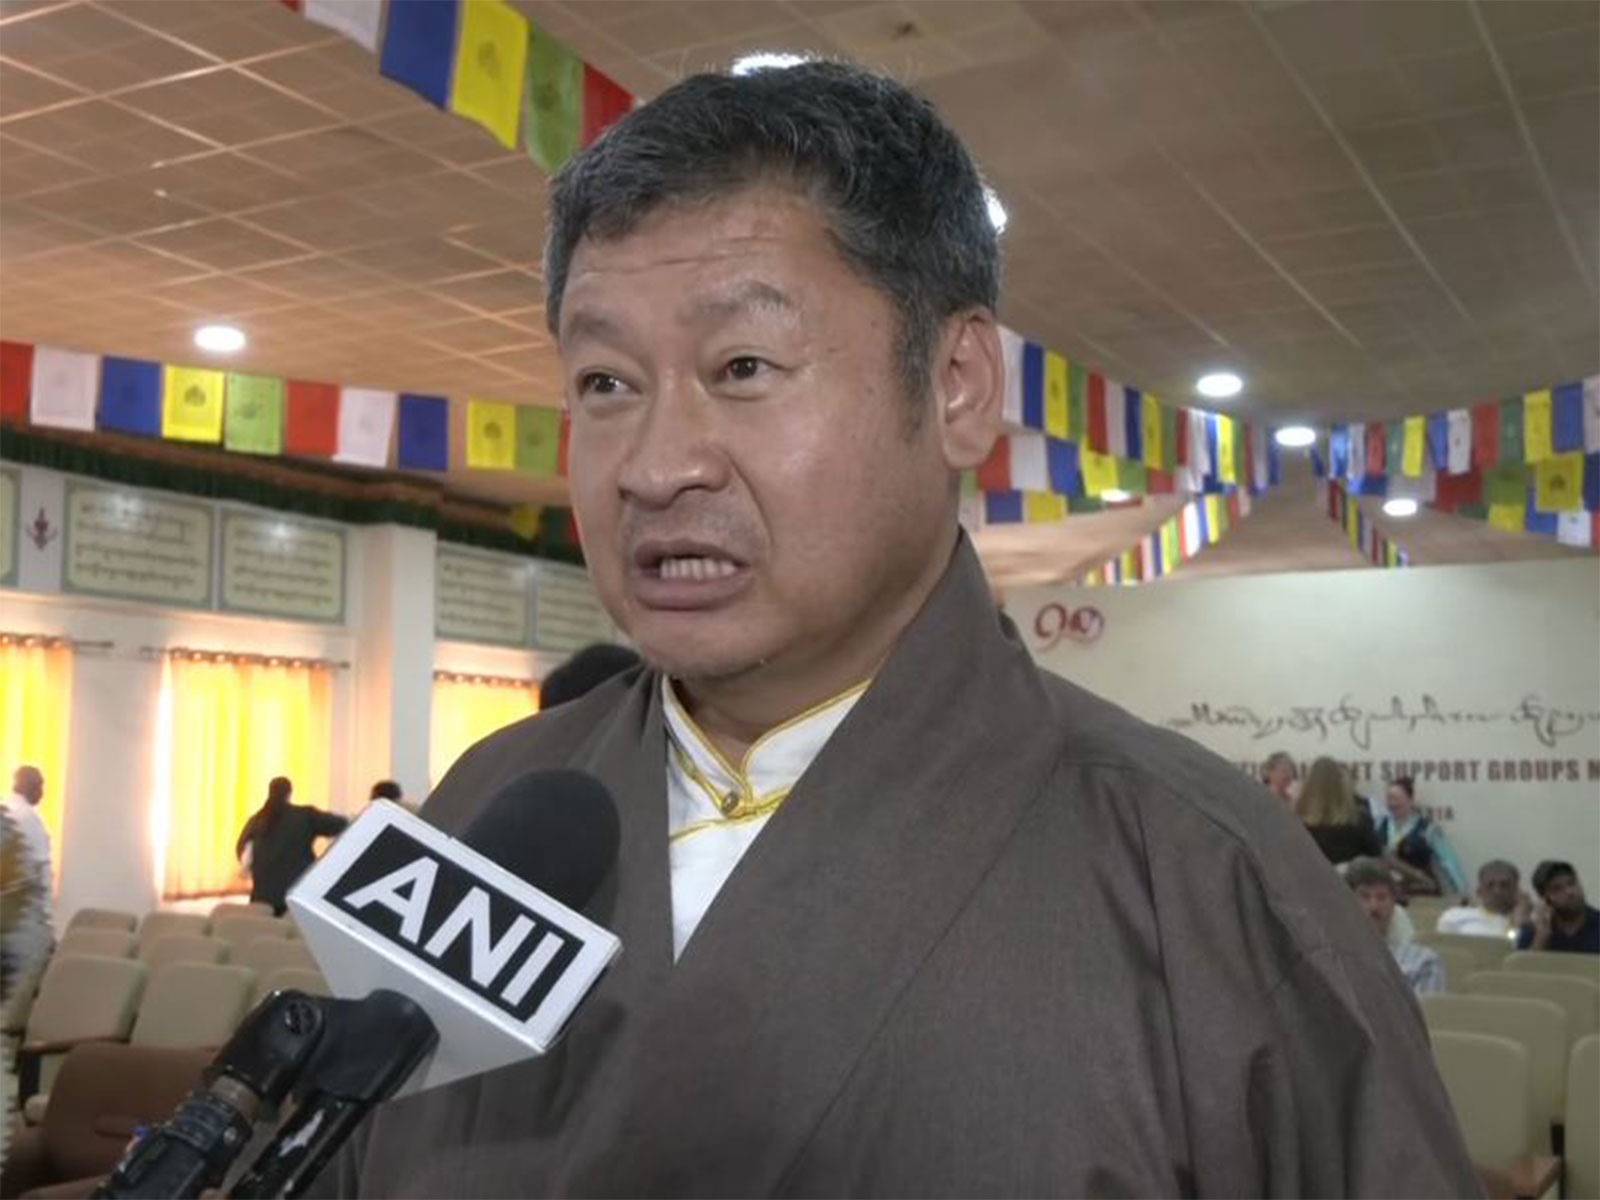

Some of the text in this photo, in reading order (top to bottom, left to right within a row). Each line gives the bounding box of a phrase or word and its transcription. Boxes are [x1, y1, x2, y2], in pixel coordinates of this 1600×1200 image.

[1380, 759, 1479, 781] SUPPORT
[1487, 759, 1580, 781] GROUPS
[343, 855, 566, 1007] ANI
